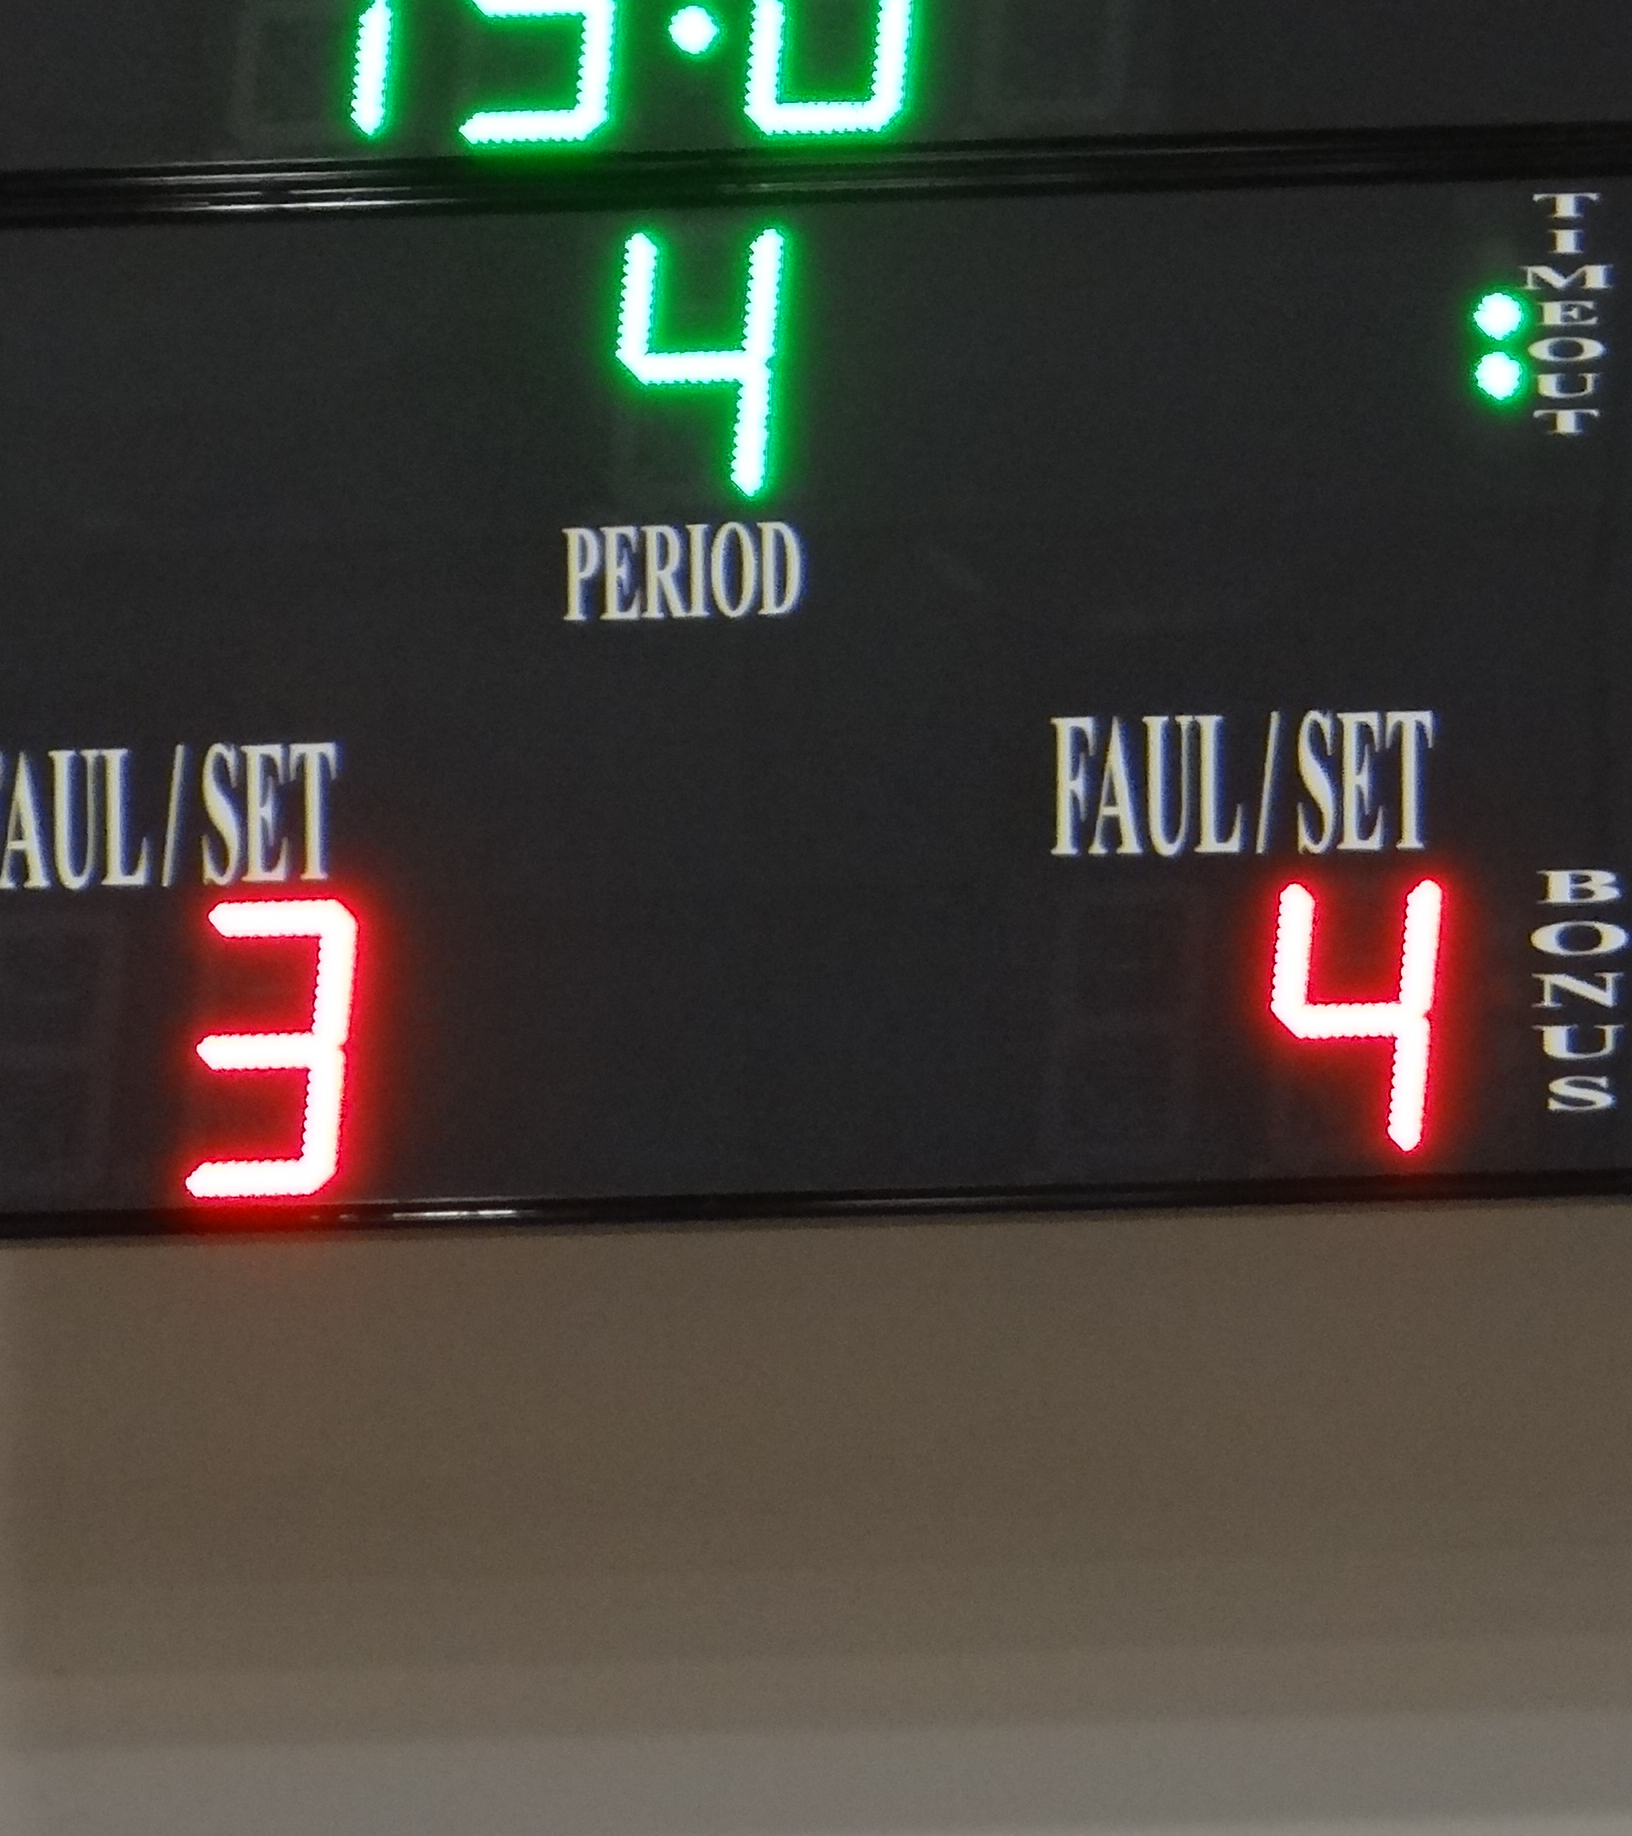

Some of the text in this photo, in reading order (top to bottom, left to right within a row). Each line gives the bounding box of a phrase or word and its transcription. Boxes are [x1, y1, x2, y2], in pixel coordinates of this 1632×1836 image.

[614, 227, 786, 498] 4
[1518, 190, 1616, 436] TIMEOUT
[563, 520, 804, 622] PERIOD
[184, 892, 367, 1207] 3
[1269, 877, 1449, 1155] 4
[1530, 868, 1630, 1114] BONUS
